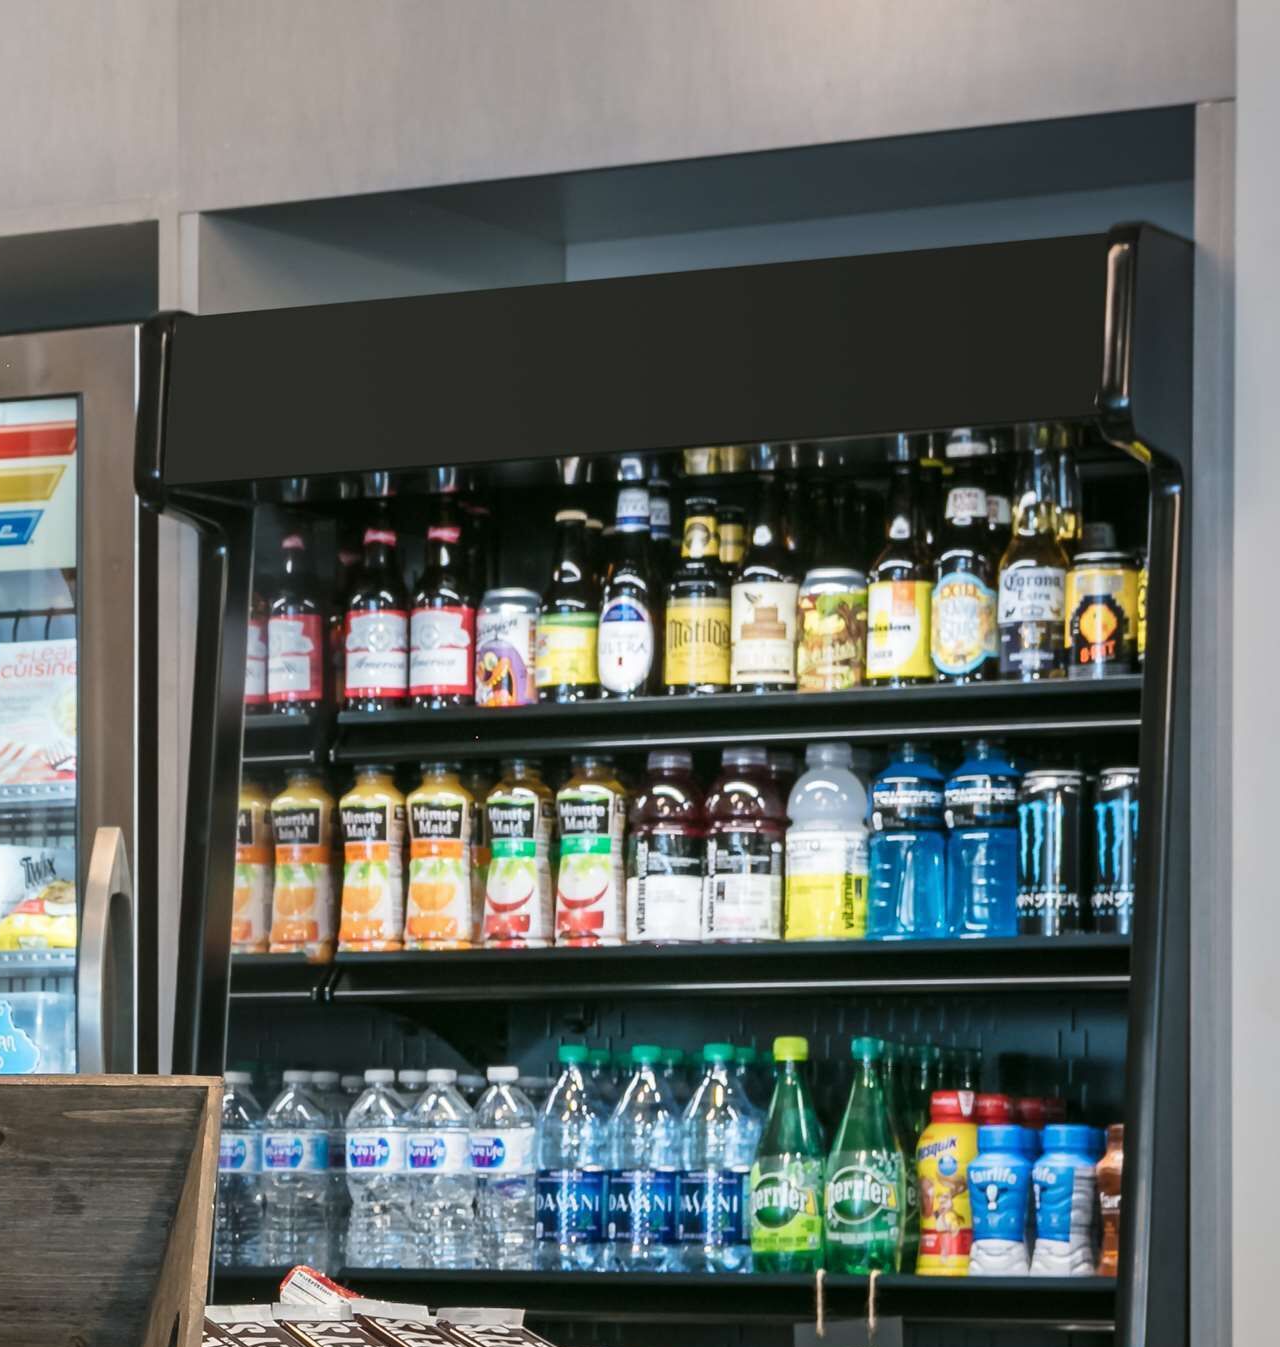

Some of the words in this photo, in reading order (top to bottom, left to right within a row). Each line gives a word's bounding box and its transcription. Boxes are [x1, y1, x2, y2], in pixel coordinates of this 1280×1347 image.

[1004, 572, 1061, 592] Corona
[342, 811, 384, 825] Minute
[413, 807, 459, 824] Minute
[488, 808, 531, 824] Minute
[559, 803, 609, 820] Minute
[346, 825, 377, 838] Maid
[419, 820, 452, 835] Maid
[493, 820, 523, 835] Maid
[564, 817, 600, 832] Maid
[19, 854, 57, 889] Twix
[970, 1166, 1018, 1185] fairlife
[296, 1269, 334, 1298] Nutrition
